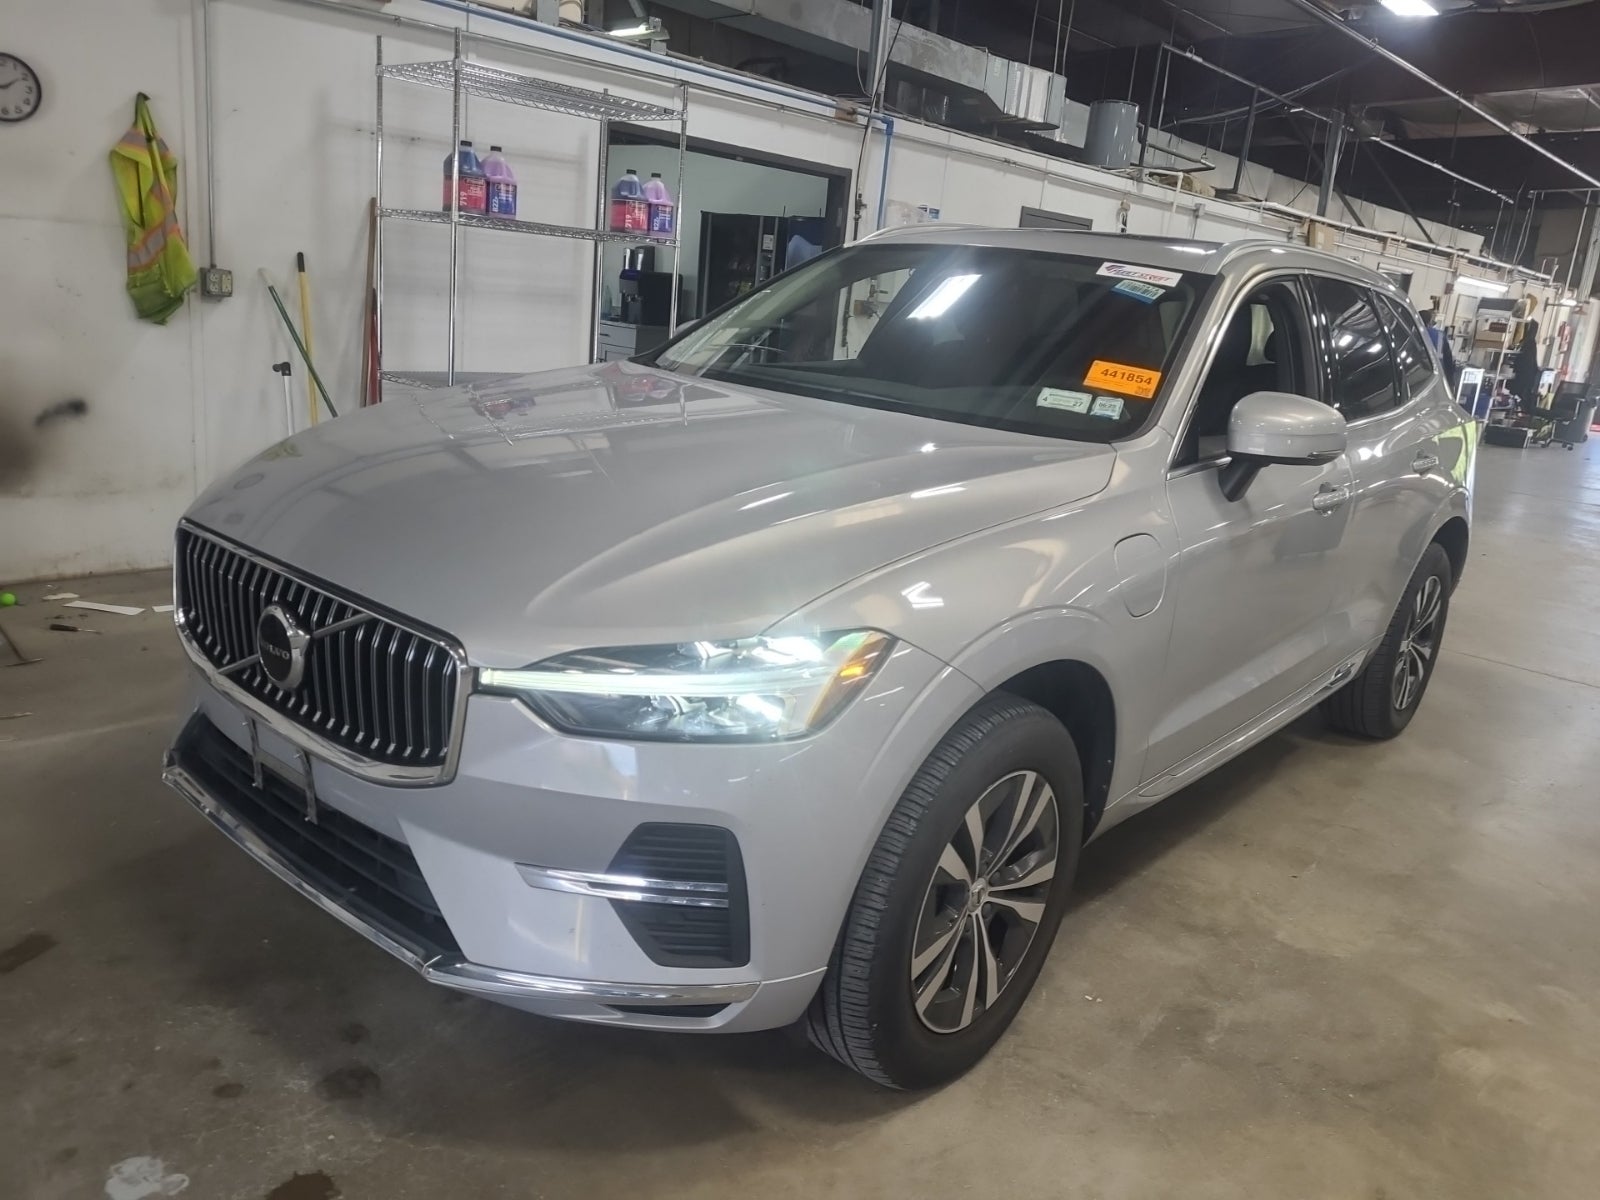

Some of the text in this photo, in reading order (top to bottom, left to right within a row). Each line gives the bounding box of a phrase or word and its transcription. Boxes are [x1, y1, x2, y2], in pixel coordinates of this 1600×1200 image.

[20, 72, 29, 82] 2
[24, 85, 33, 95] 3
[459, 191, 468, 206] 719
[624, 213, 633, 229] 719
[1100, 368, 1153, 386] 441854
[260, 640, 290, 660] VOLVO
